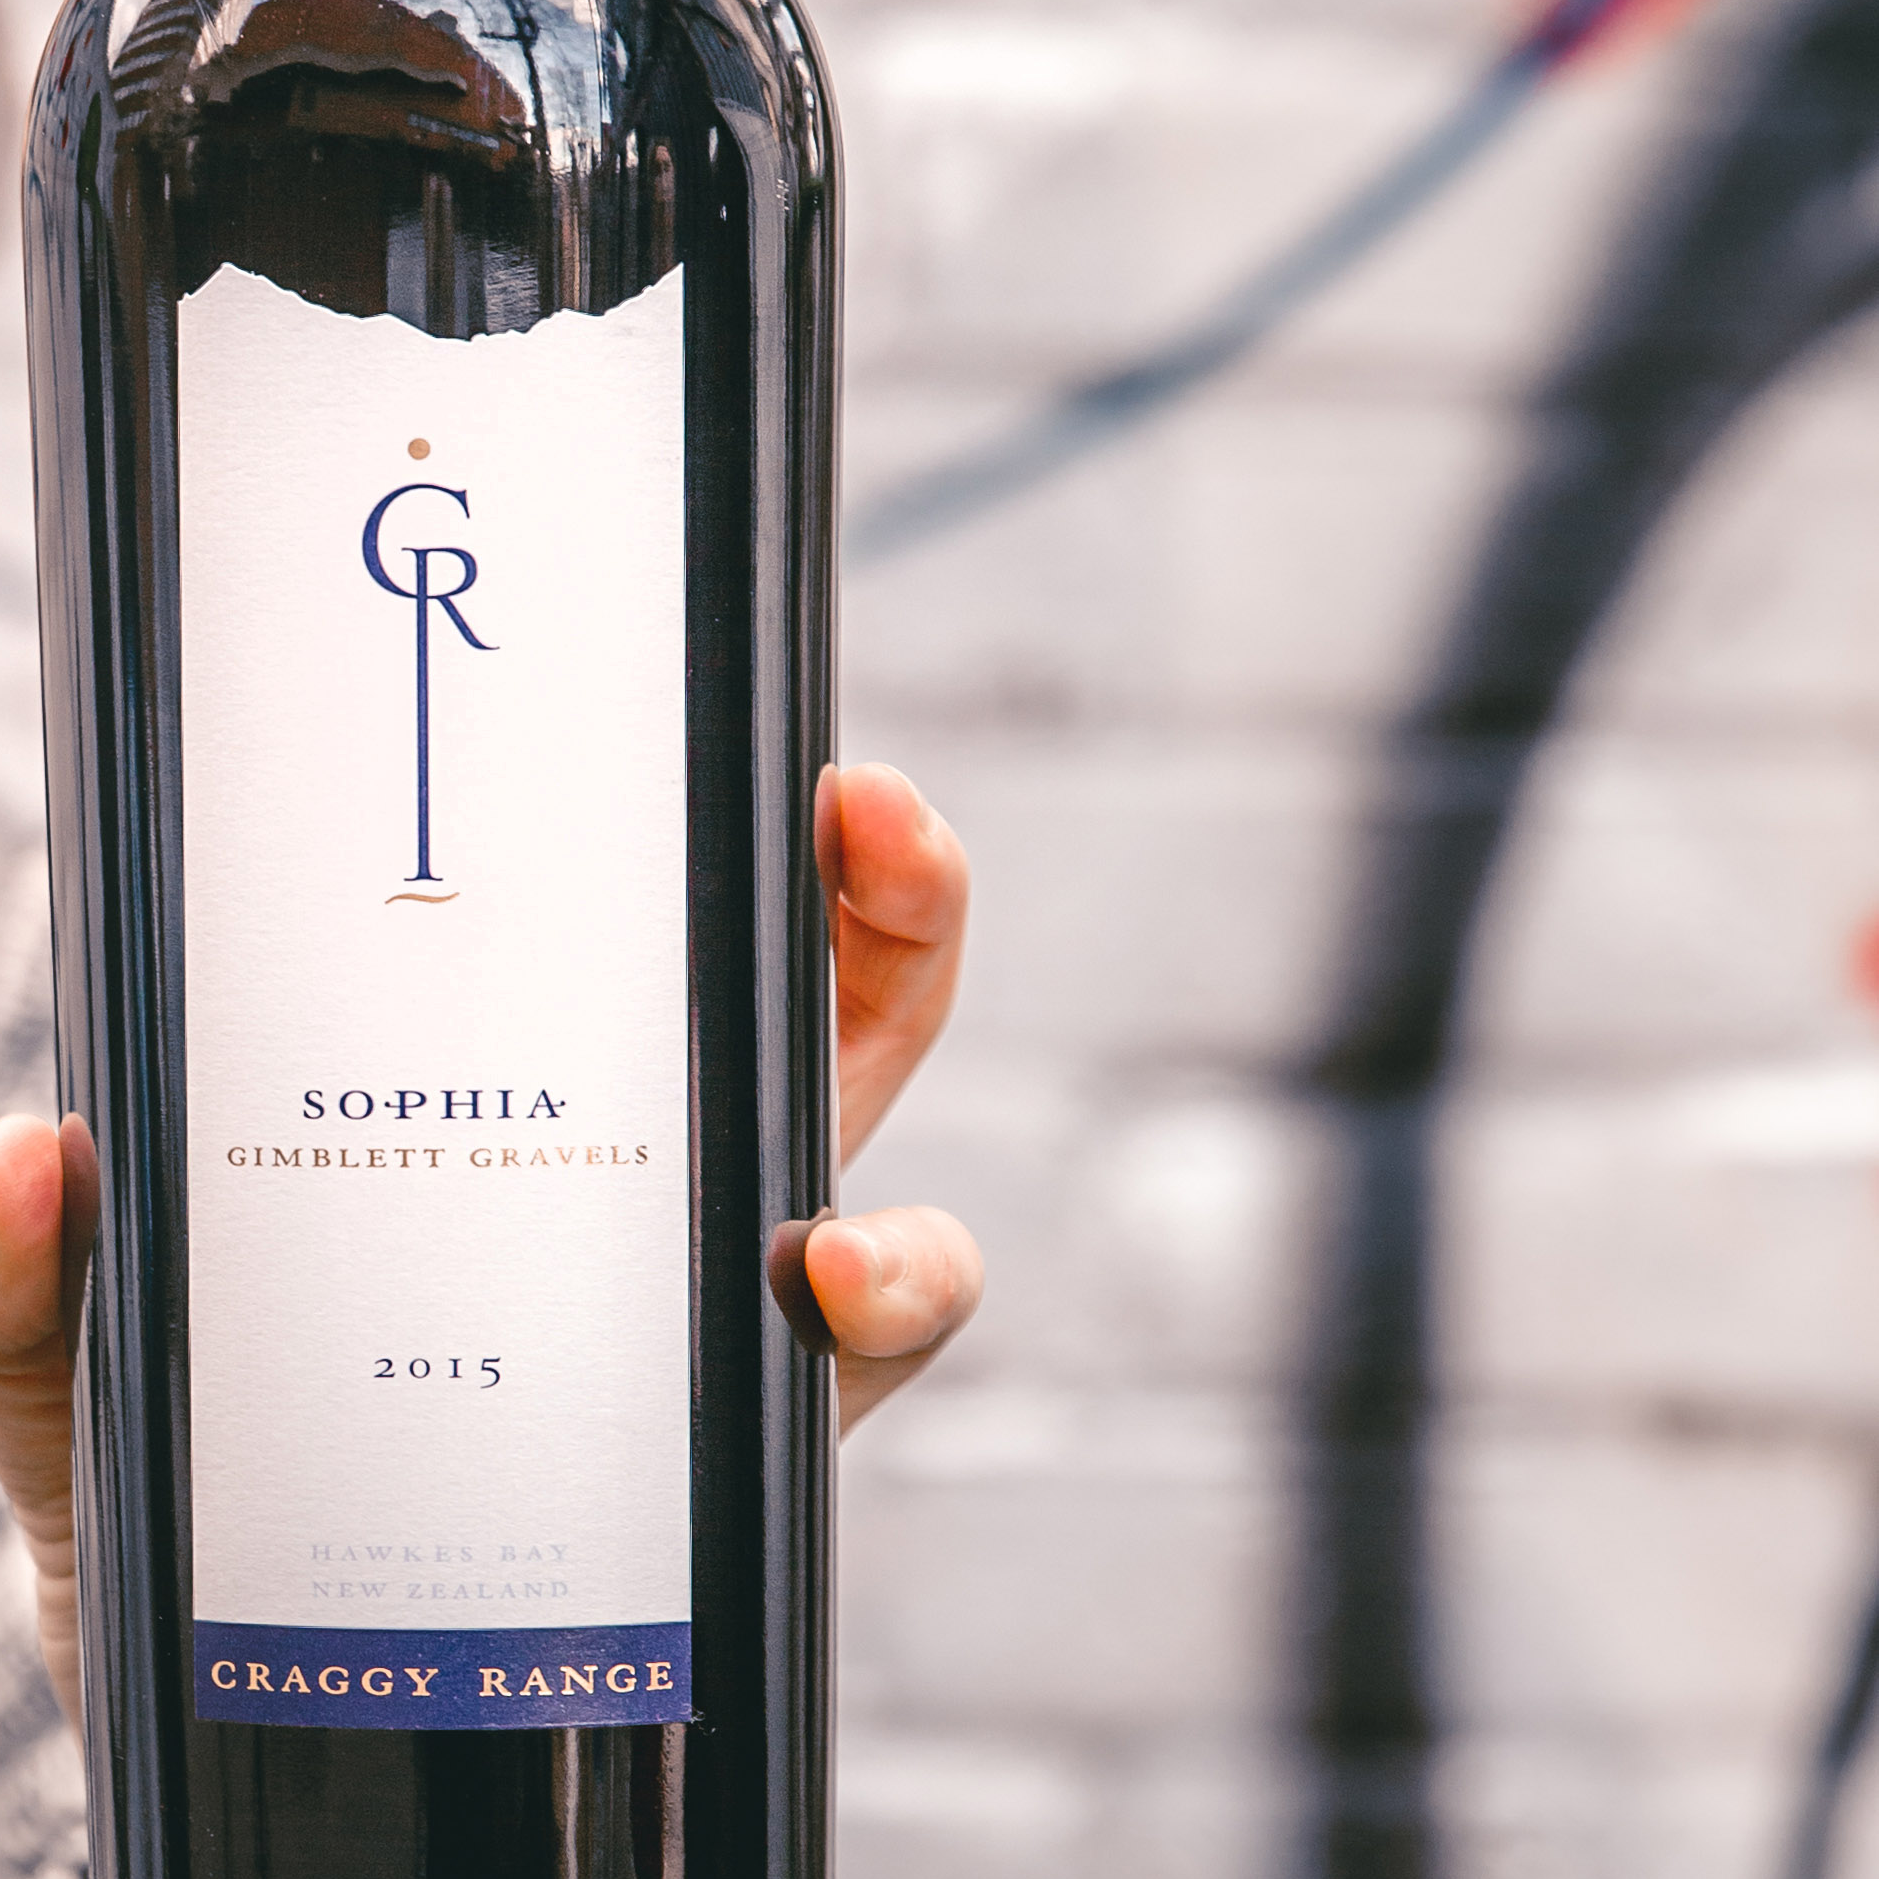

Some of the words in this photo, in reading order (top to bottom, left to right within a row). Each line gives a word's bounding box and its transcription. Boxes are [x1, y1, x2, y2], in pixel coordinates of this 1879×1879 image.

[303, 1089, 566, 1120] SOPHIA
[227, 1146, 446, 1169] GIMBLETT
[469, 1144, 649, 1168] GRAVELS
[373, 1357, 502, 1389] 2015
[312, 1544, 474, 1563] HAWKES
[499, 1544, 570, 1562] BAY
[312, 1581, 388, 1599] NEW
[407, 1581, 569, 1600] ZEALAND
[211, 1660, 440, 1697] CRAGGY
[478, 1662, 675, 1698] RANGE
